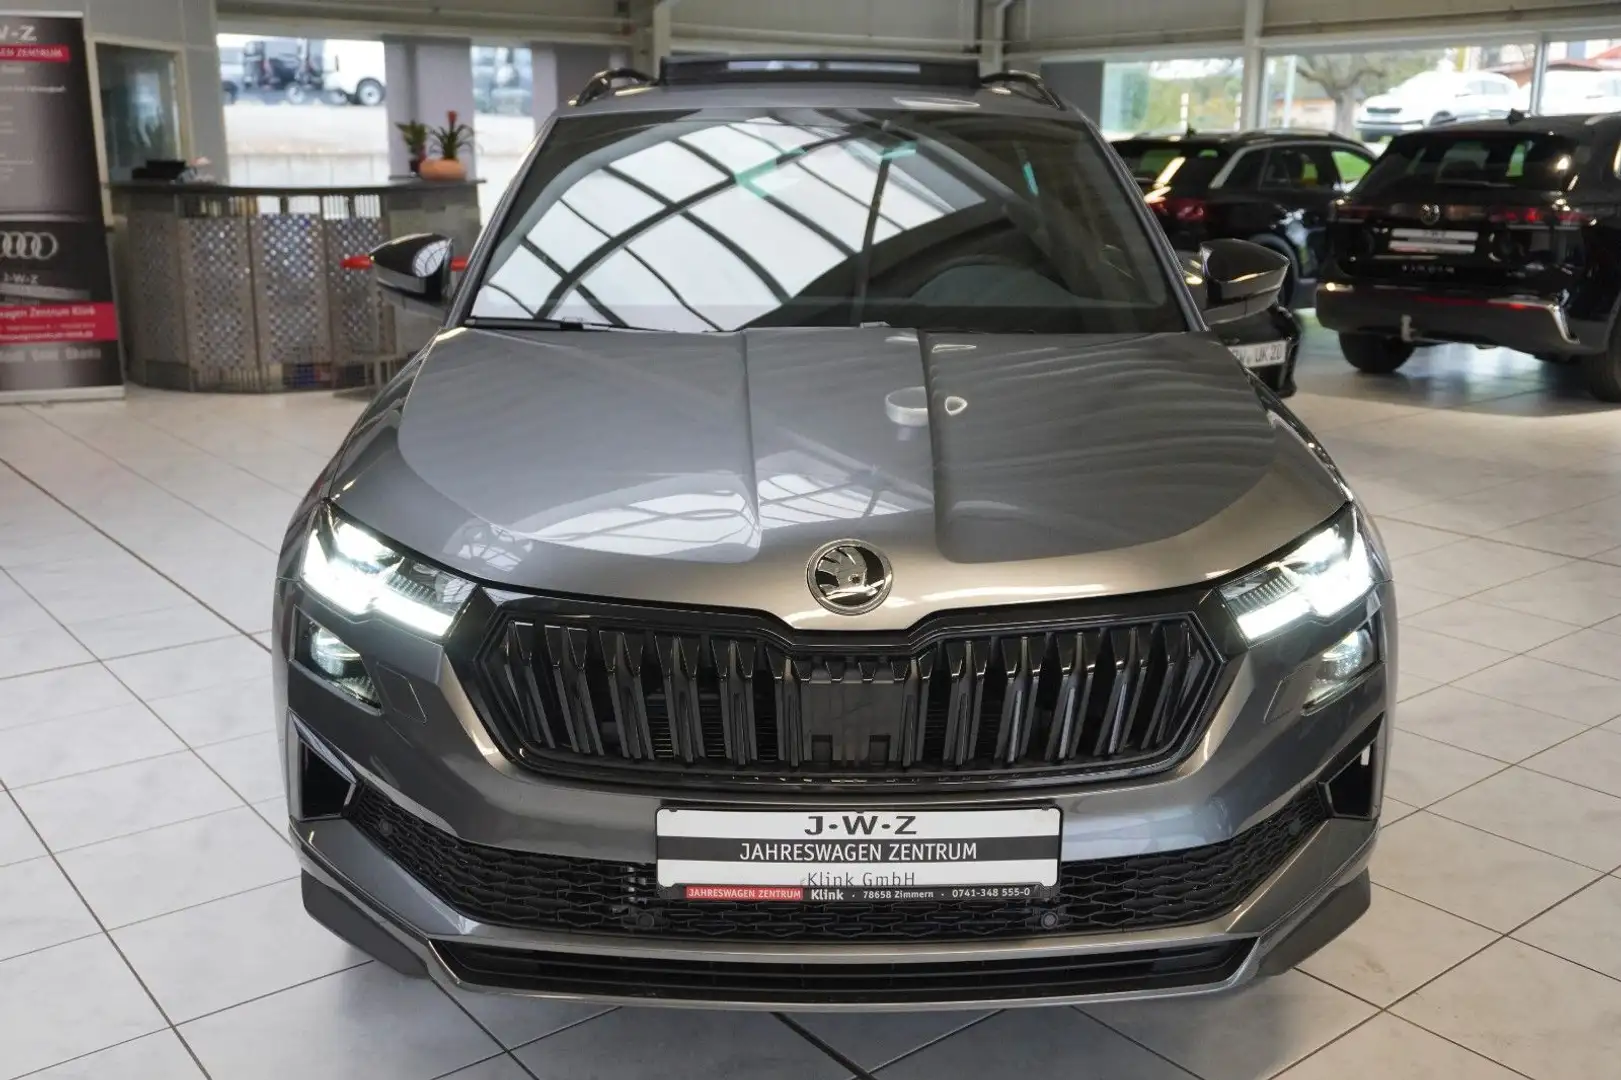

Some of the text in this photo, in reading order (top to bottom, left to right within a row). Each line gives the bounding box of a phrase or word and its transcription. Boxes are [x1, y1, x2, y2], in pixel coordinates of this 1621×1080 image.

[739, 843, 978, 862] JAHRESWAGEN ZENTRUM
[808, 871, 915, 887] Klink GmbH
[688, 887, 1031, 900] JAHRESWAGEN ZENTRUM Klink 78658 Zimmern 0741-348 555-0
